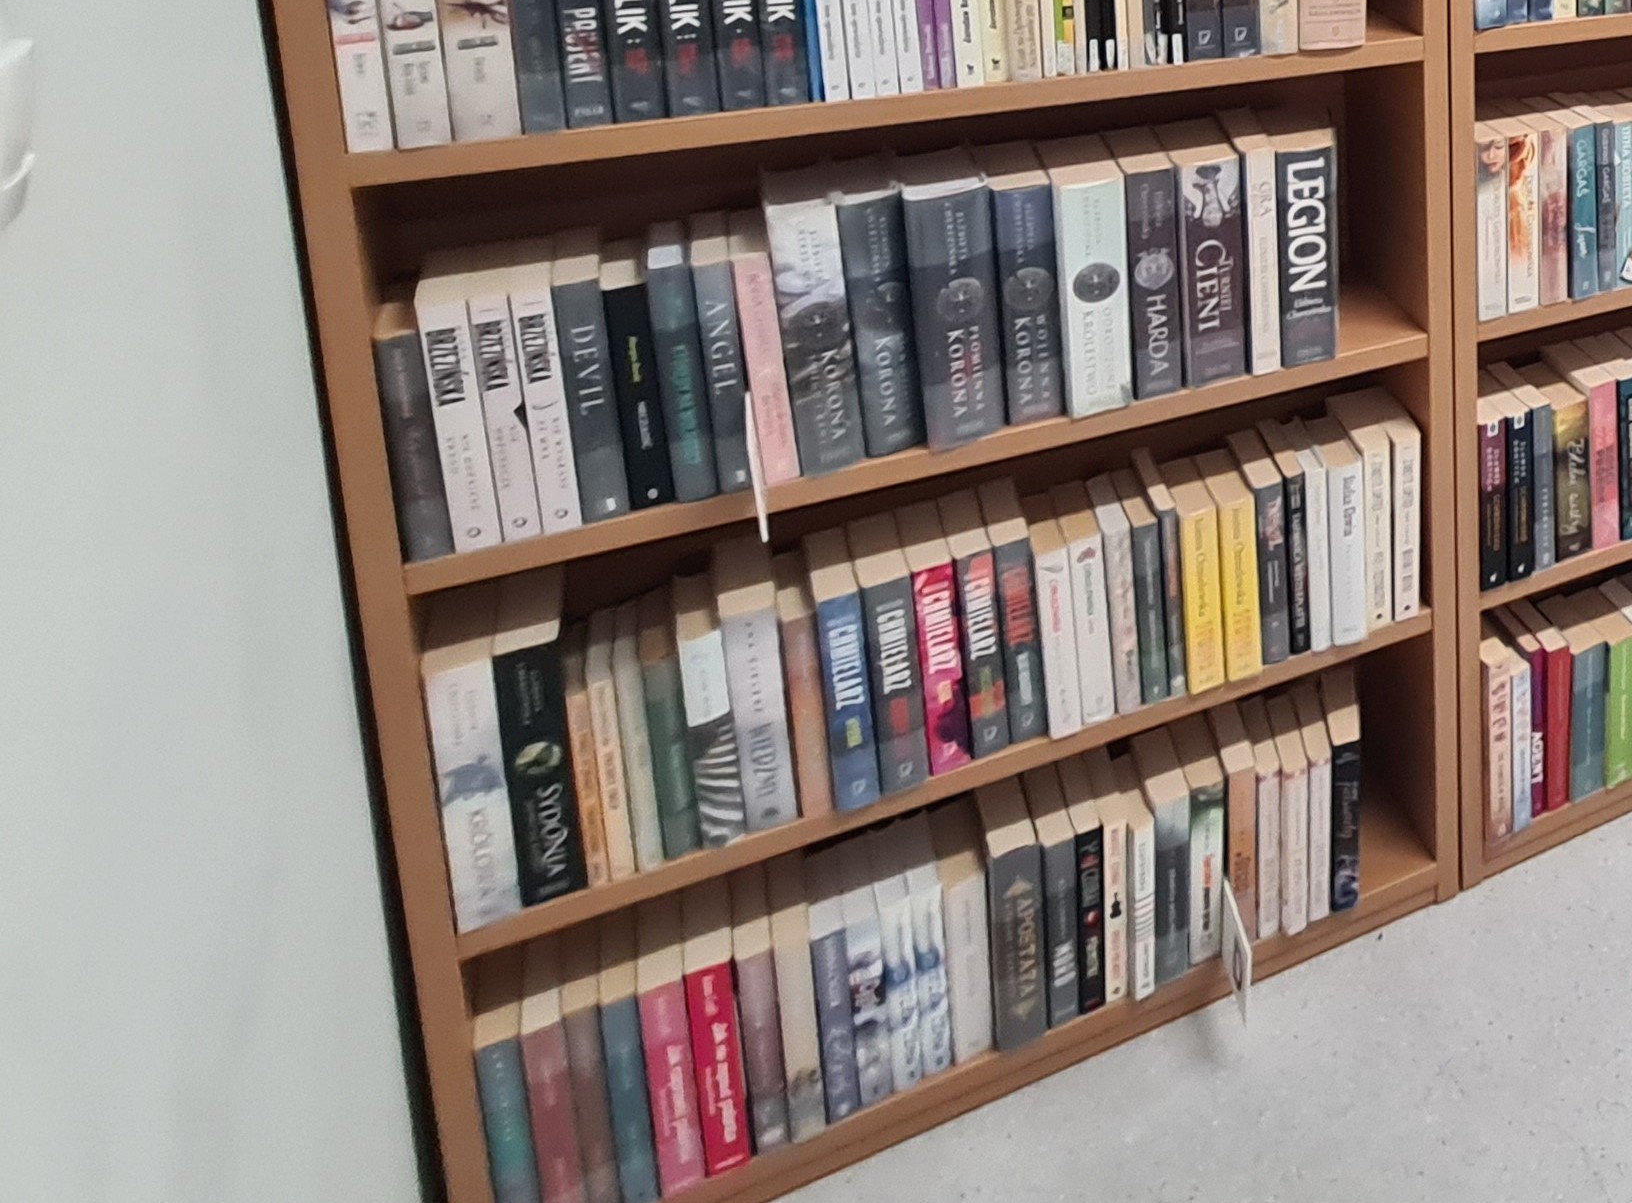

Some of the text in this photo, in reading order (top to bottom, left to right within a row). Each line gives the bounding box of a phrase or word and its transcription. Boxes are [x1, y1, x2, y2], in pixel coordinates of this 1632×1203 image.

[1575, 139, 1589, 198] GARGAŚ
[1621, 125, 1632, 209] INNA KOBIETA
[1286, 157, 1328, 293] LEGION
[1194, 239, 1228, 332] CIENI
[424, 327, 469, 407] BRZEZIŃSKA
[473, 319, 512, 392] BRZEZIŃSKA
[517, 313, 556, 385] BRZEZIŃSKA
[570, 325, 606, 416] DEVIL
[704, 300, 739, 397] ANGEL
[946, 329, 969, 419] KORONA
[1013, 316, 1035, 406] KORONA
[1036, 314, 1053, 400] WOJENNA
[1145, 294, 1169, 376] HARDA
[819, 349, 848, 441] KORONA
[873, 336, 897, 427] KORONA
[877, 609, 912, 695] CHMIELARZ
[922, 590, 956, 674] CHMIELARZ
[963, 578, 997, 661] CHMIELARZ
[828, 624, 865, 710] CHMIELARZ
[1530, 731, 1545, 783] AGENT
[536, 783, 569, 878] SYDONIA
[1014, 898, 1038, 997] APOSTATA
